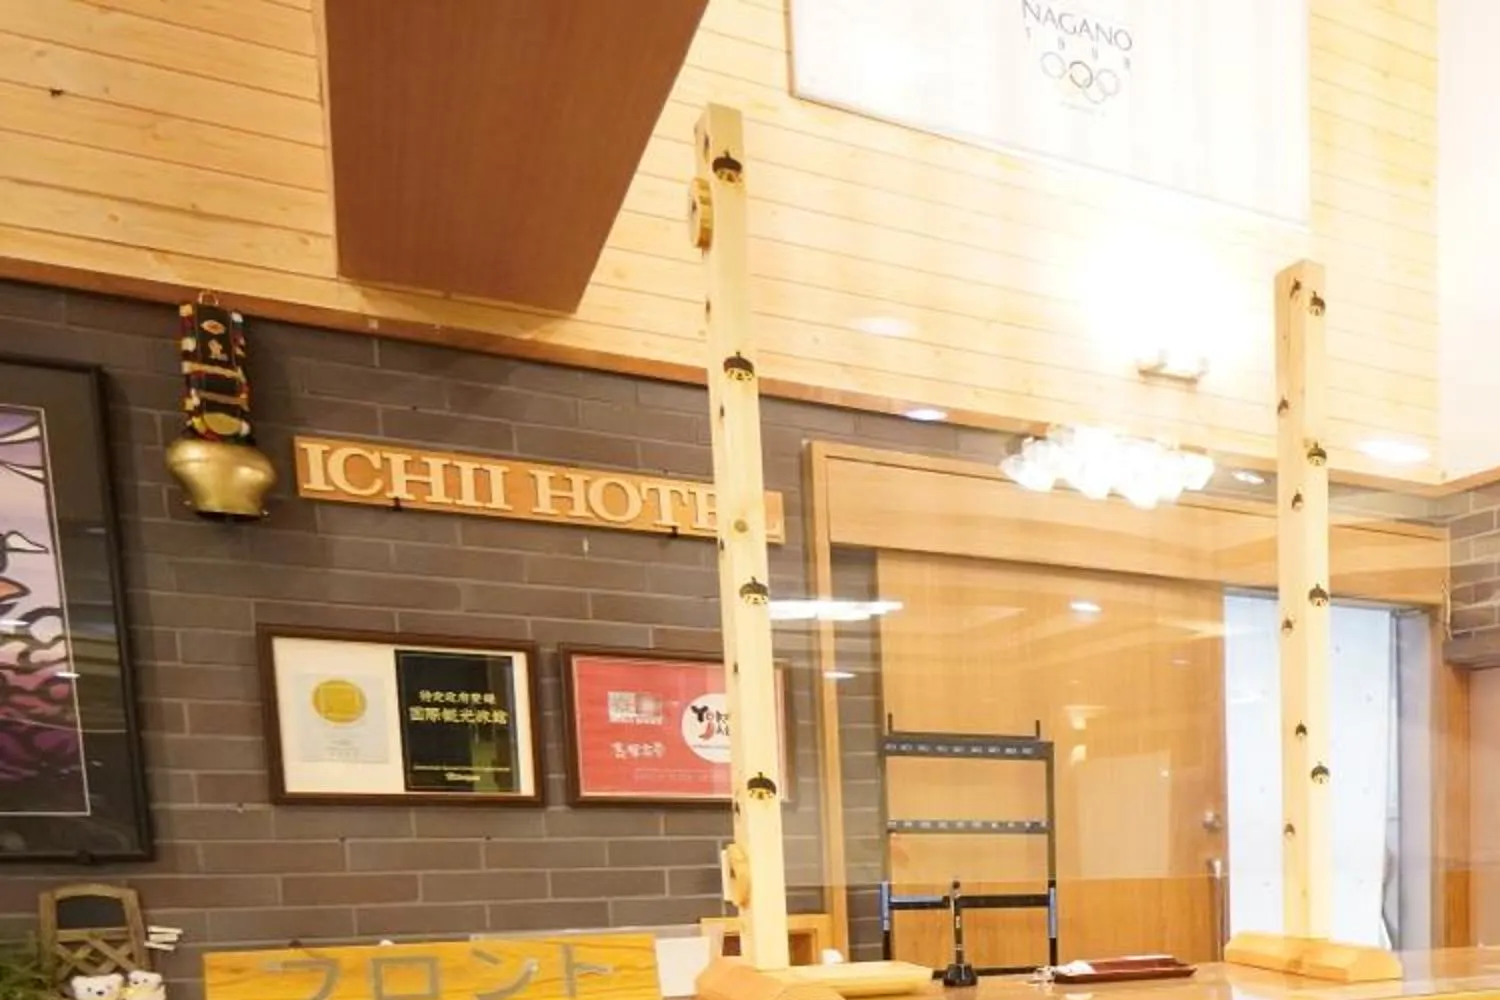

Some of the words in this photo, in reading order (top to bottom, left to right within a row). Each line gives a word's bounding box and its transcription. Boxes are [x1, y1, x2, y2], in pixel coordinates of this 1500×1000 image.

[1021, 0, 1133, 52] NAGANO
[300, 442, 513, 511] ICHII
[528, 469, 782, 537] HOTE
